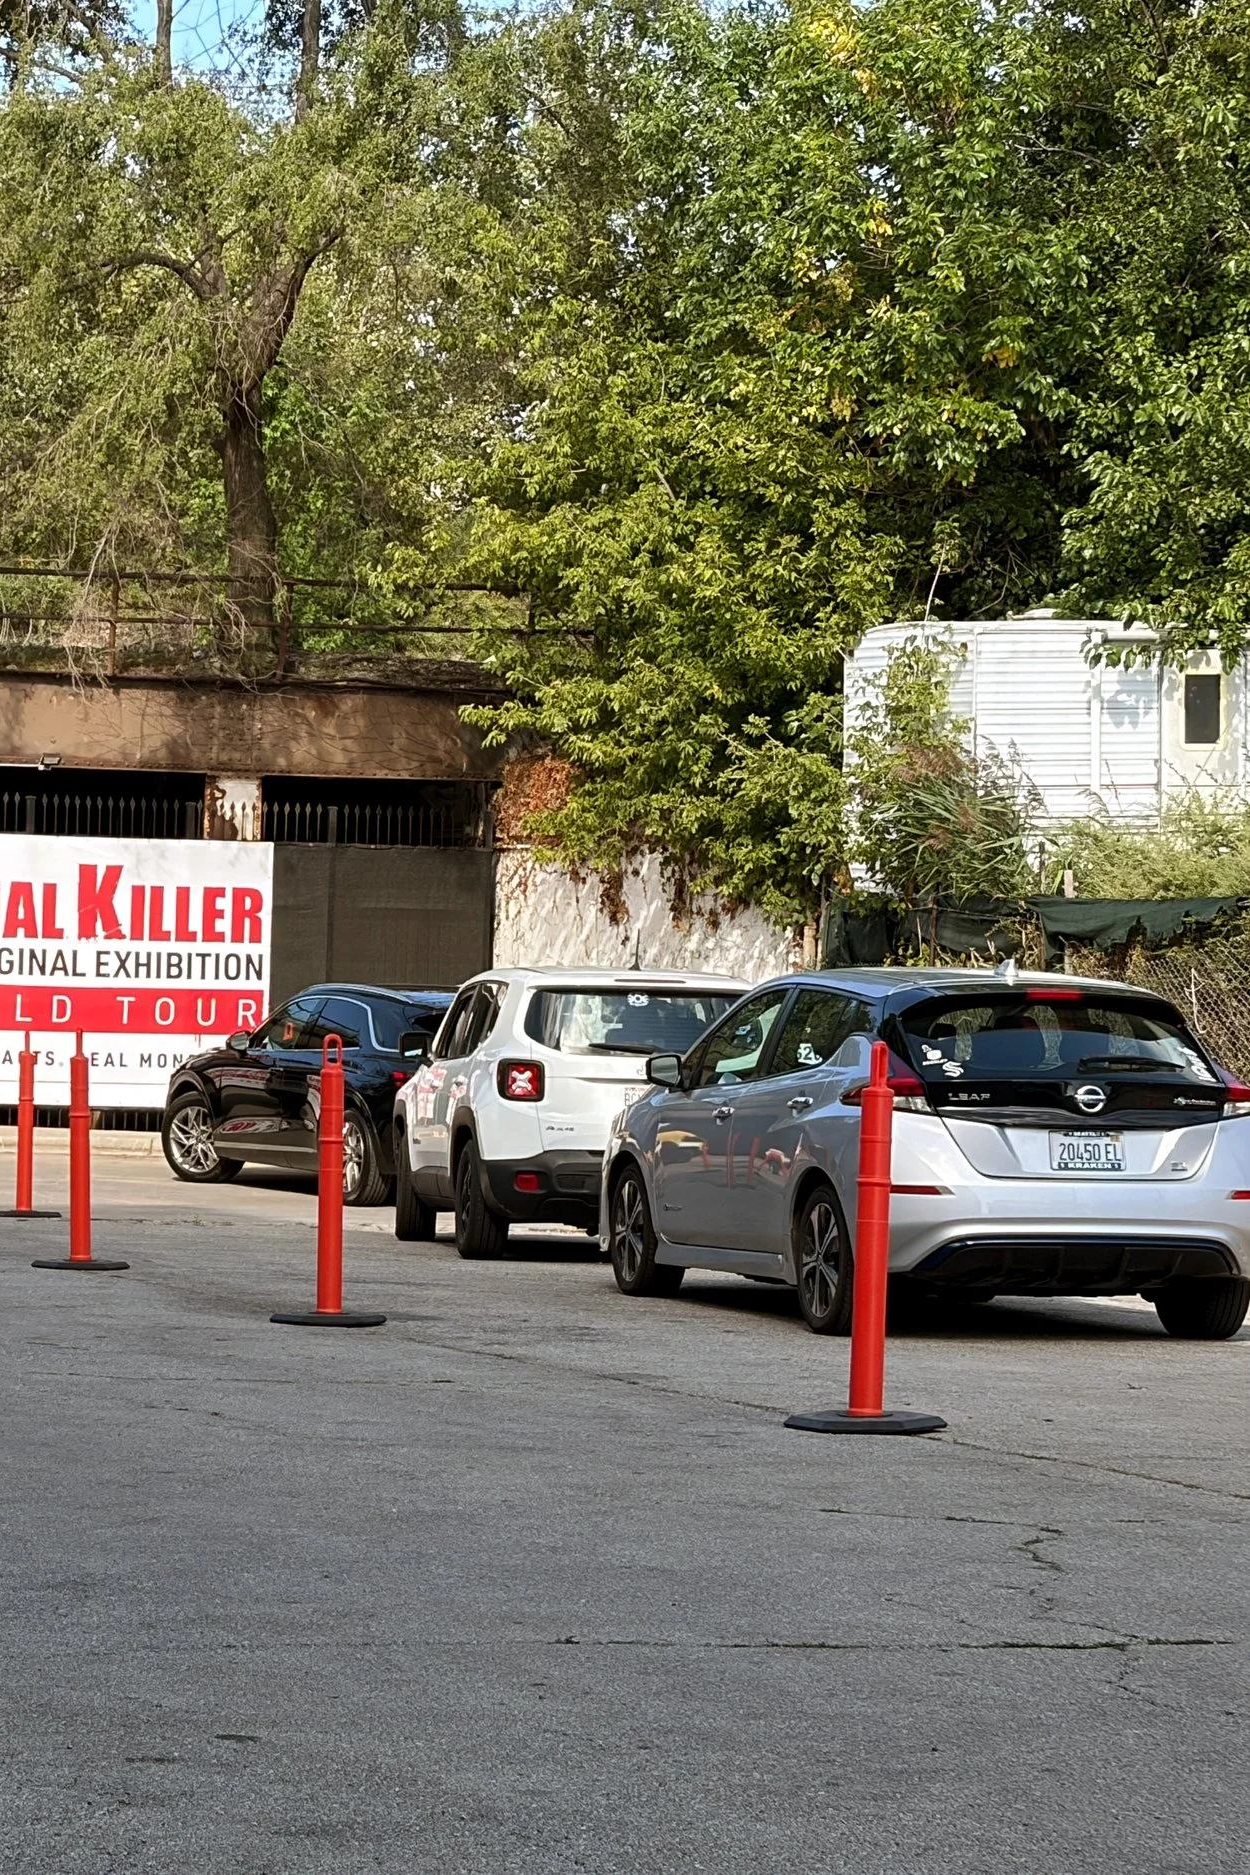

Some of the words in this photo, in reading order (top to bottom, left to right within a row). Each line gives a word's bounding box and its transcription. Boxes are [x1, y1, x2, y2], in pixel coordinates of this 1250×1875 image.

[77, 864, 264, 944] KILLER
[96, 950, 264, 981] EXHIBITION
[116, 996, 257, 1027] TOUR
[1059, 1143, 1101, 1161] 20450
[1105, 1143, 1122, 1161] EL
